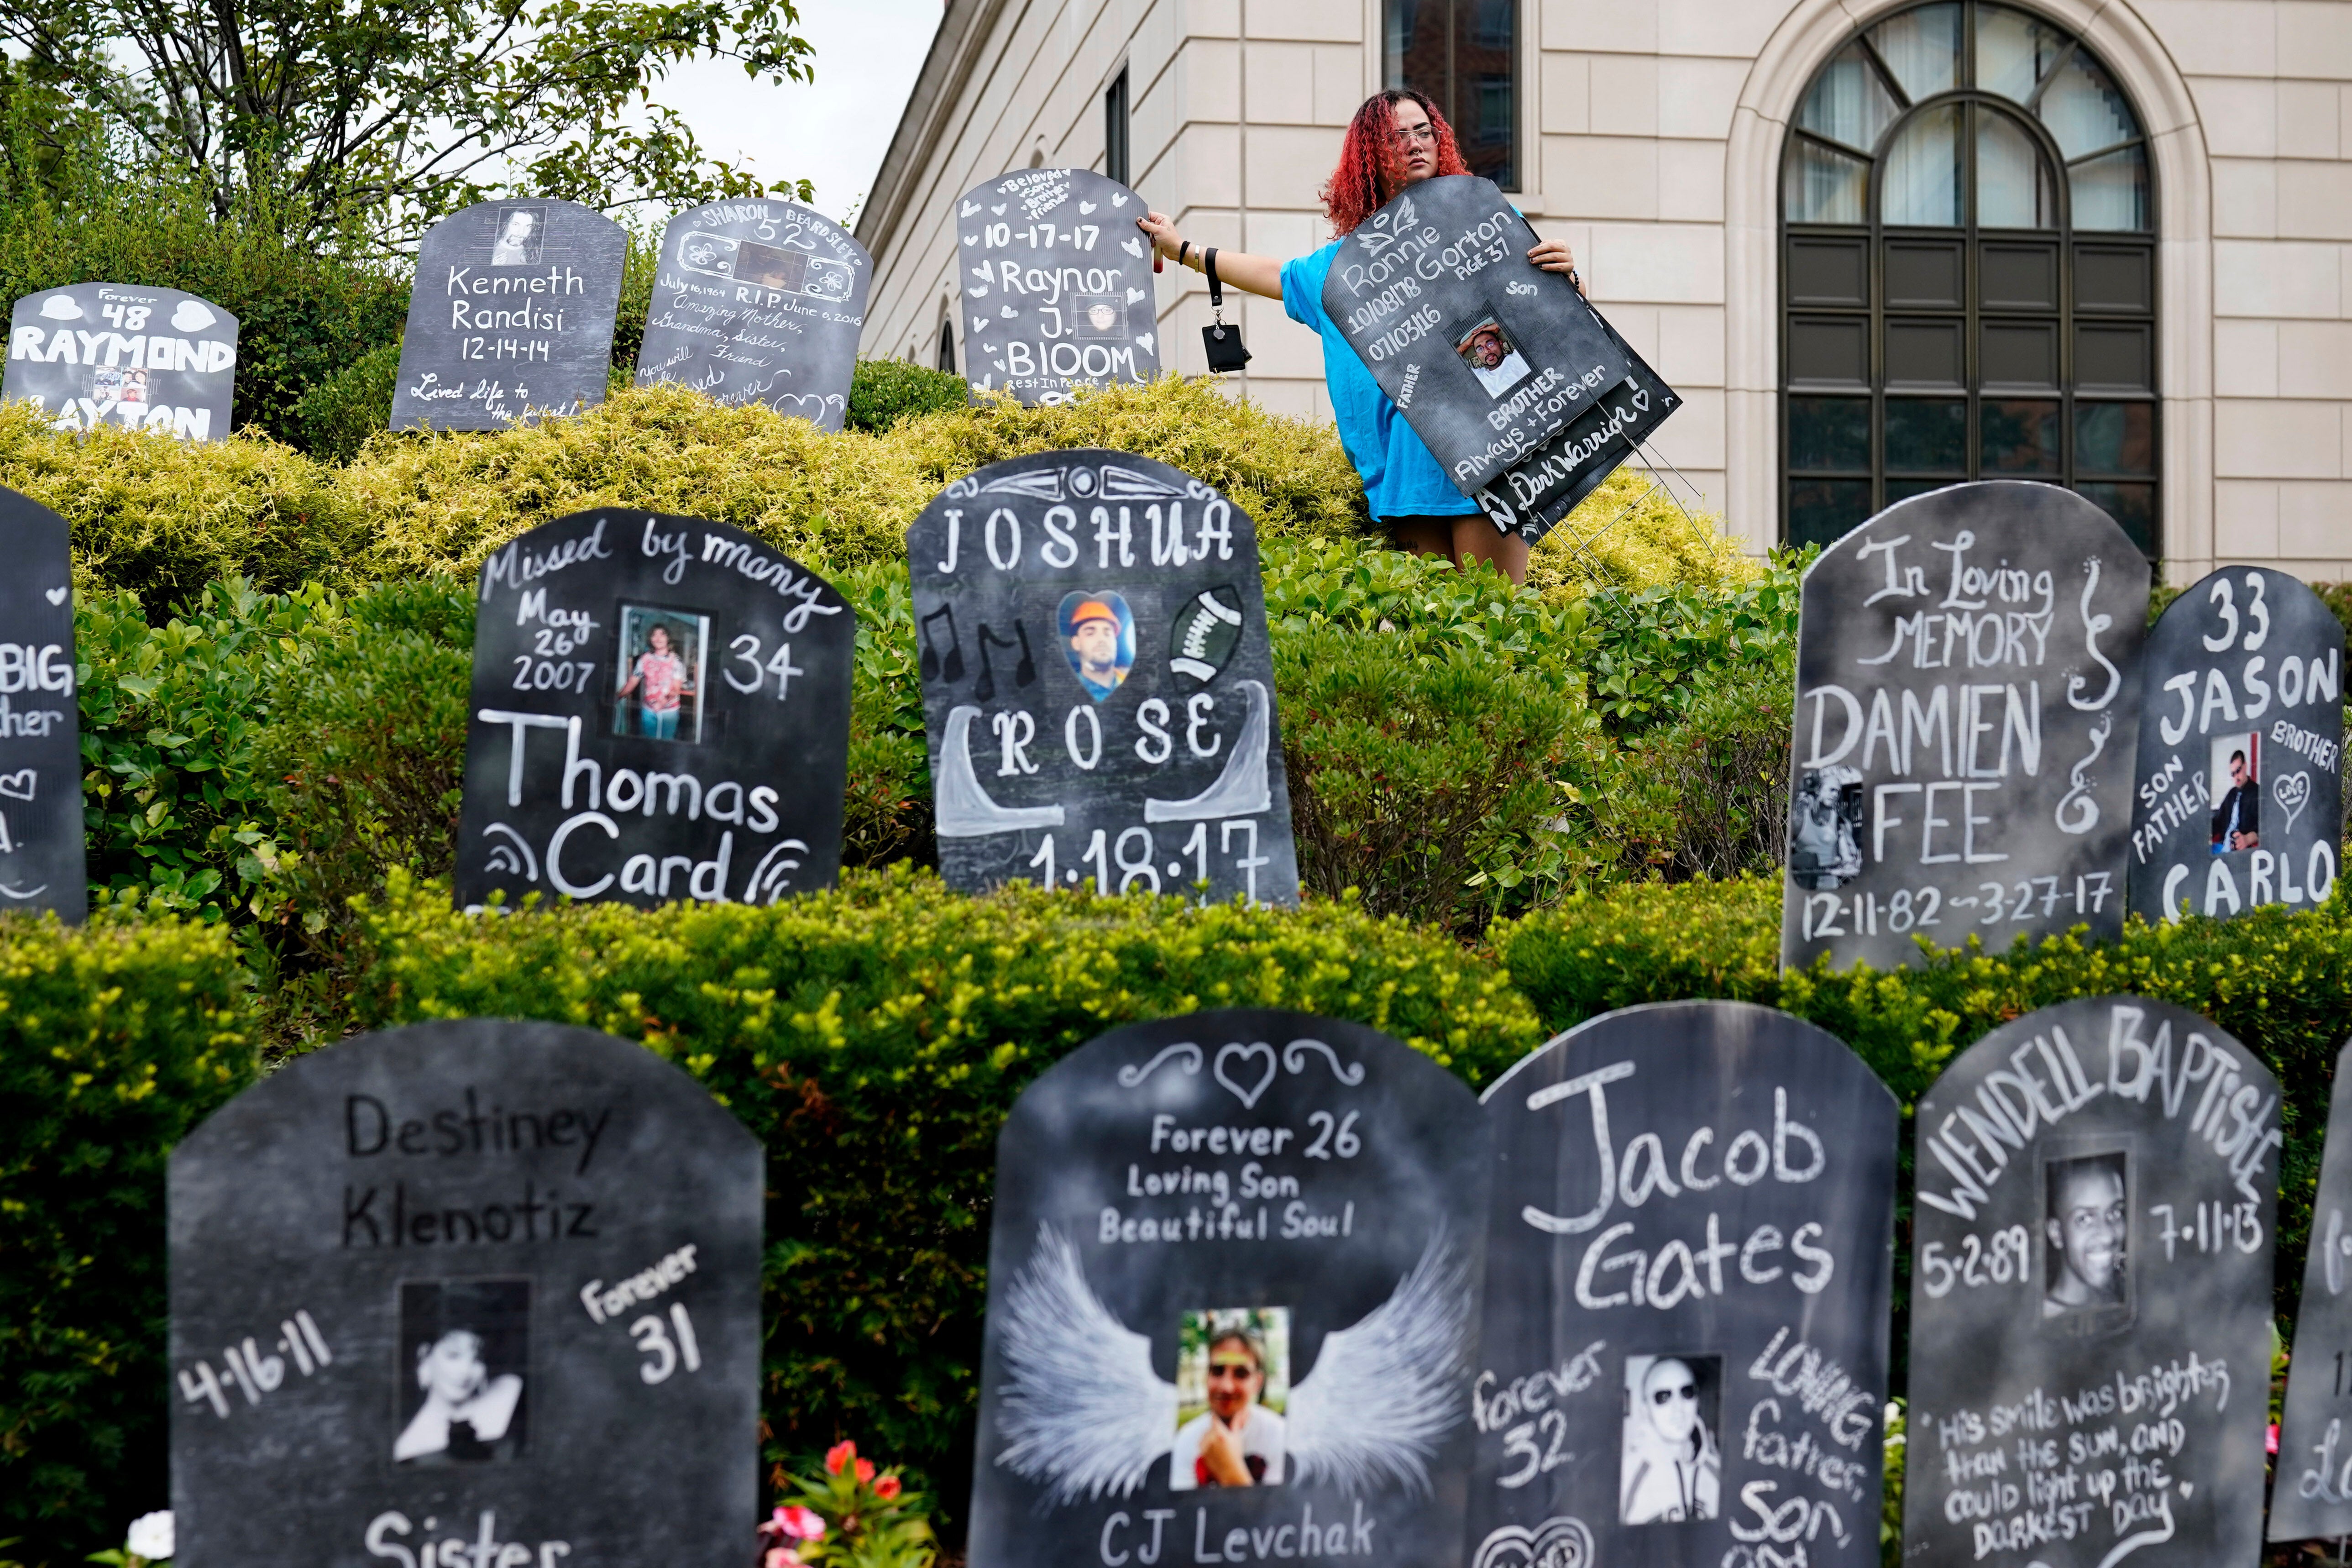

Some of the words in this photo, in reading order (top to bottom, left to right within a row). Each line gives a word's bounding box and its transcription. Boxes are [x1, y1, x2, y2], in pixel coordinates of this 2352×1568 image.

[1002, 169, 1063, 192] Beloved
[702, 205, 770, 227] SHARON
[786, 209, 857, 261] BEARDSLEY
[754, 218, 817, 250] 52
[985, 222, 1100, 251] 10-17-17
[1341, 226, 1441, 298] Ronnie
[1415, 211, 1512, 281] Gorton
[1454, 255, 1488, 281] AGE
[1485, 239, 1510, 263] 37
[98, 288, 158, 304] Forever
[448, 266, 583, 296] Kenneth
[660, 273, 688, 295] July
[736, 287, 782, 308] R.I.P.
[783, 299, 817, 316] June
[673, 294, 736, 325] Amazing
[1001, 260, 1122, 305] Raynor
[1348, 276, 1421, 336] 10/08/78
[102, 304, 152, 330] 48
[453, 297, 564, 332] Randisi
[1368, 304, 1441, 361] 07/03/16
[11, 326, 236, 372] RAYMOND
[463, 337, 549, 362] 12-14-14
[709, 344, 775, 367] Friend
[411, 373, 463, 401] Lived
[470, 378, 504, 411] life
[515, 383, 528, 400] to
[1040, 378, 1057, 388] In
[1397, 363, 1420, 409] FATHER
[1487, 367, 1565, 431] BROTHER
[1455, 427, 1524, 482] Always
[1533, 365, 1605, 422] Forever
[1509, 461, 1565, 511] Dark
[1556, 406, 1637, 472] Warrior
[937, 499, 1233, 575] JOSHUA
[482, 518, 612, 603] Missed
[641, 517, 693, 586] by
[702, 533, 843, 634] many
[1856, 534, 1932, 608] In
[1932, 530, 2054, 619] Loving
[517, 589, 600, 645] May
[1856, 610, 2054, 669] MEMORY
[2202, 571, 2270, 652] 33
[534, 629, 576, 657] 26
[723, 634, 804, 701] 34
[513, 655, 596, 694] 2007
[2160, 648, 2338, 746] JASON
[992, 692, 1221, 778] ROSE
[1801, 681, 2042, 778] DAMIEN
[2270, 720, 2338, 774] BROTHER
[477, 709, 780, 834] Thomas
[2140, 755, 2184, 809] SON
[1873, 781, 2009, 865] FEE
[2132, 770, 2210, 865] FATHER
[546, 811, 733, 903] Card
[2162, 839, 2336, 926] CARLO
[344, 1086, 612, 1176] Destiney
[1150, 1114, 1294, 1155] Forever
[1303, 1110, 1362, 1161] 26
[1522, 1060, 1825, 1234] Jacob
[1918, 1024, 2104, 1222] WENDELL
[1126, 1164, 1230, 1208] Loving
[1239, 1162, 1300, 1199] Son
[1099, 1206, 1268, 1245] Beautiful
[1281, 1201, 1355, 1239] Soul
[579, 1243, 698, 1325] Forever
[1575, 1213, 1835, 1311] Gates
[629, 1301, 702, 1385] 31
[1496, 1408, 1576, 1489] 32
[365, 1509, 572, 1568] Sister
[1100, 1507, 1177, 1568] CJ
[1194, 1498, 1378, 1564] Levchak
